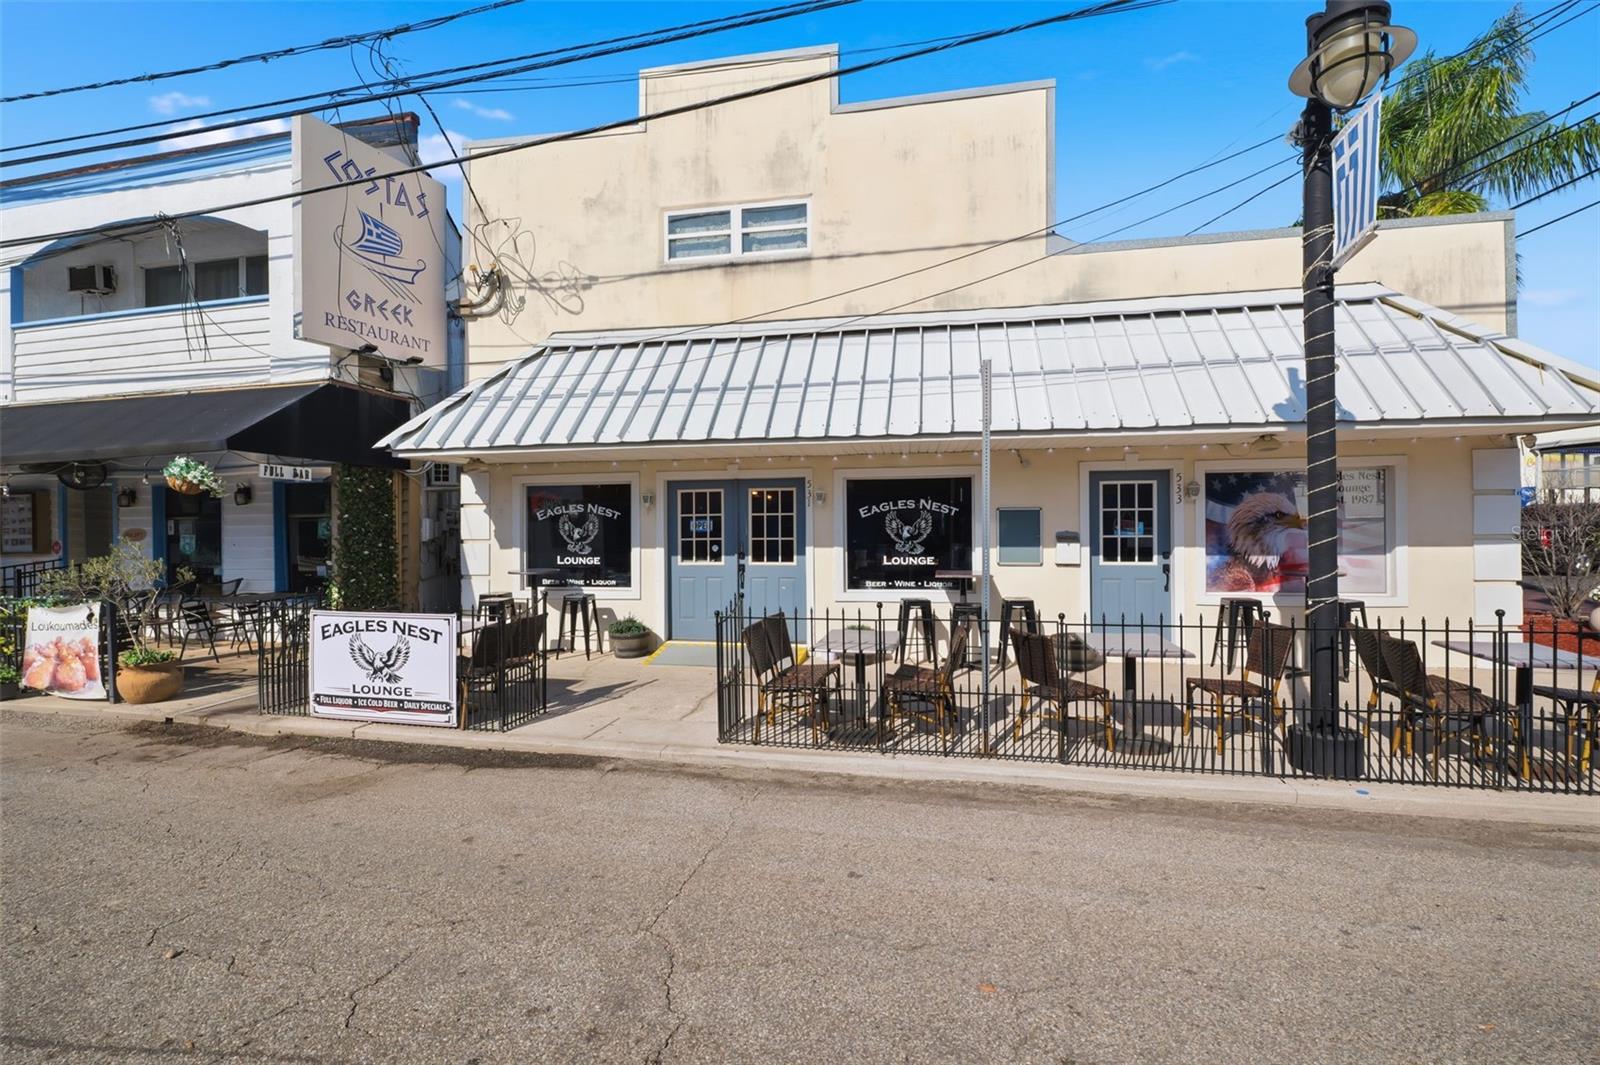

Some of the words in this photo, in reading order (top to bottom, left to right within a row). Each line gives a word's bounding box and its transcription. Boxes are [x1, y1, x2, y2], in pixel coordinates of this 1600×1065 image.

[324, 150, 430, 219] COSTAS
[346, 288, 414, 328] GREEK
[324, 311, 431, 352] RESTAURANT
[263, 465, 285, 477] FULL
[293, 468, 310, 480] BAR
[1351, 495, 1375, 504] 1987
[536, 504, 585, 521] EAGLES
[587, 503, 621, 520] NEST
[859, 499, 916, 519] EAGLES
[919, 498, 960, 517] NEST
[556, 555, 601, 565] LOUNGE
[882, 555, 935, 566] LOUNGE
[894, 580, 916, 588] WINE
[31, 620, 98, 632] Loukoumades
[321, 620, 388, 641] EAGLES
[392, 620, 443, 644] NEST
[352, 684, 413, 697] LOUNGE
[320, 696, 333, 704] FULL
[332, 696, 353, 705] LIQUOR
[358, 698, 368, 706] ICE
[367, 698, 383, 707] COLD
[383, 699, 398, 708] BEER
[404, 700, 421, 709] DAILY
[420, 702, 447, 711] SPECIALS
